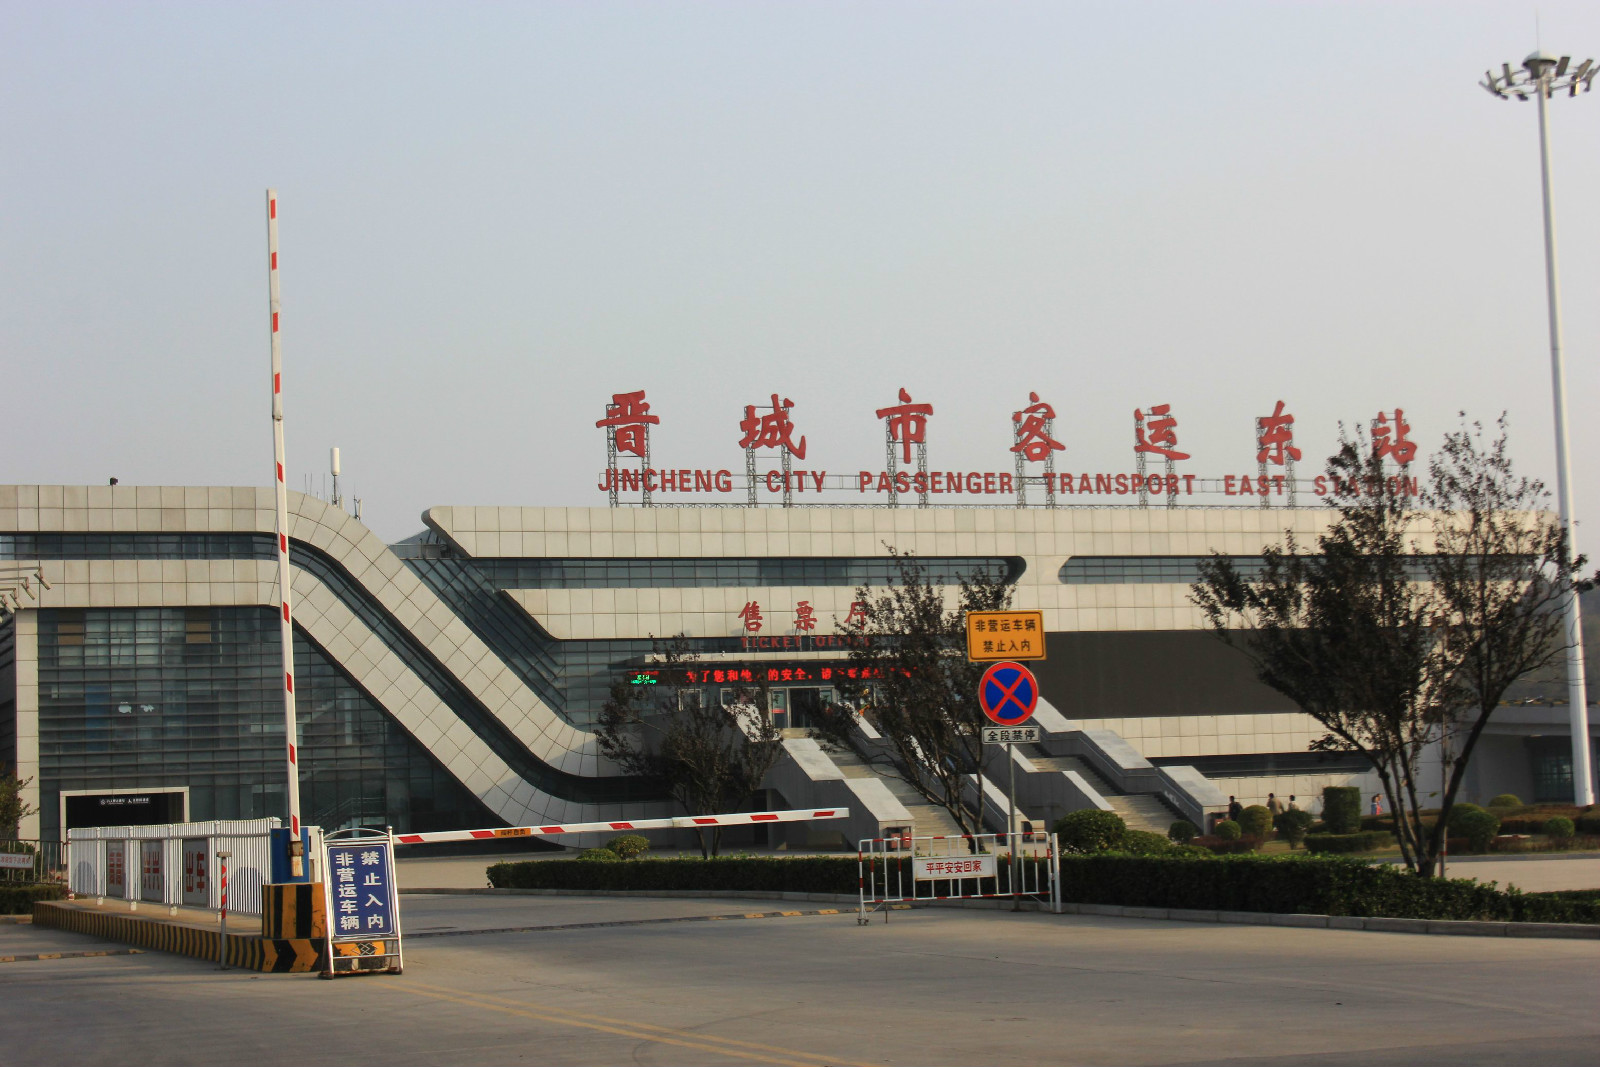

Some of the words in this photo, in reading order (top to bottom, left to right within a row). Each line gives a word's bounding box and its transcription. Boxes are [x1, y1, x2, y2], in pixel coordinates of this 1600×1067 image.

[596, 388, 1418, 465] 晋城市客运东站
[597, 468, 733, 493] JINCHENG
[766, 470, 827, 493] CITY
[859, 471, 1013, 495] PASSENGER
[1042, 472, 1196, 496] TRANSPORT
[1223, 474, 1285, 496] EAST
[738, 600, 869, 632] 售票厅
[975, 619, 1036, 633] 非营运车辆
[740, 635, 802, 649] TICKET
[983, 639, 1031, 653] 禁止入内
[987, 729, 1036, 741] 全段禁停
[926, 860, 982, 875] 平平安安回家
[335, 852, 360, 931] 非营运车辆
[360, 850, 384, 929] 禁止入内
